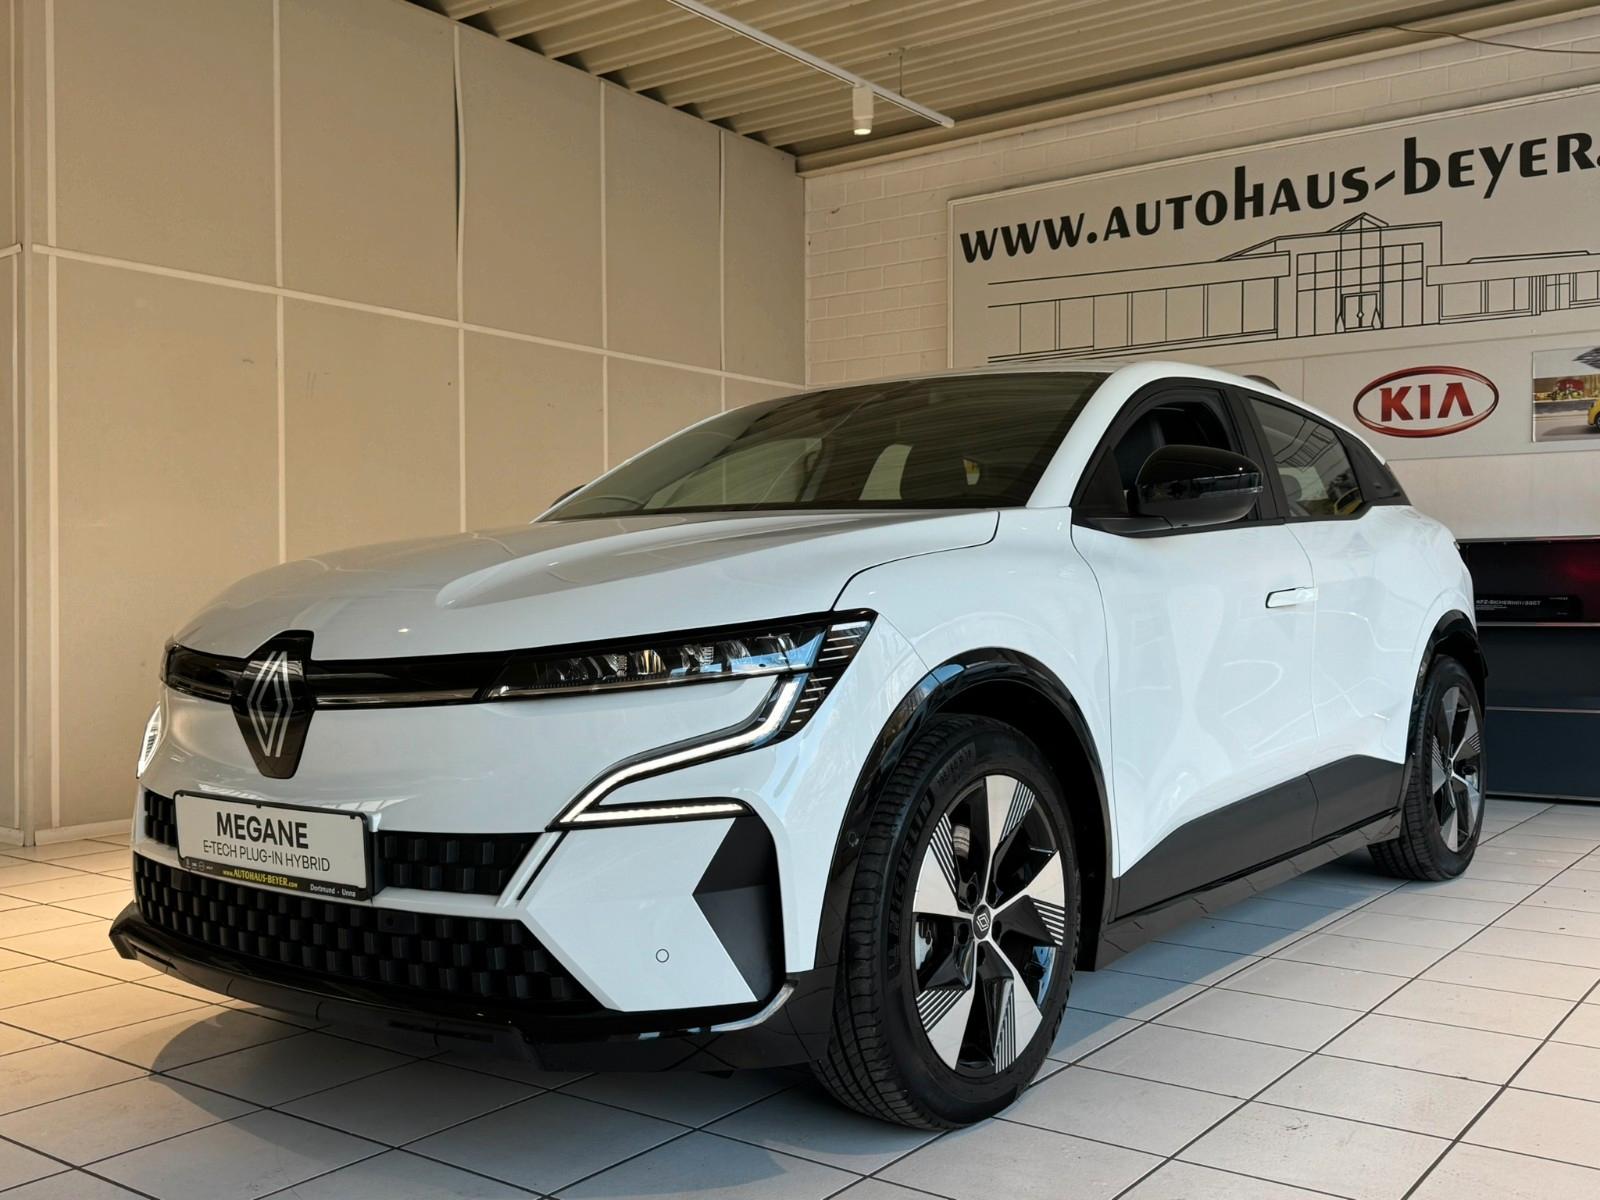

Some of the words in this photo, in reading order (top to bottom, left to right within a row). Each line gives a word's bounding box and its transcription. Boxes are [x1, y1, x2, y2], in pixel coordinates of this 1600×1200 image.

[1380, 383, 1474, 422] KIA
[216, 811, 309, 849] MEGANE
[203, 840, 237, 858] E-TECH
[239, 847, 283, 865] PLUG-IN
[285, 853, 330, 872] HYBRID
[223, 868, 298, 888] www.AUTOHAUS-BEYER.com
[310, 884, 336, 895] Dortmund
